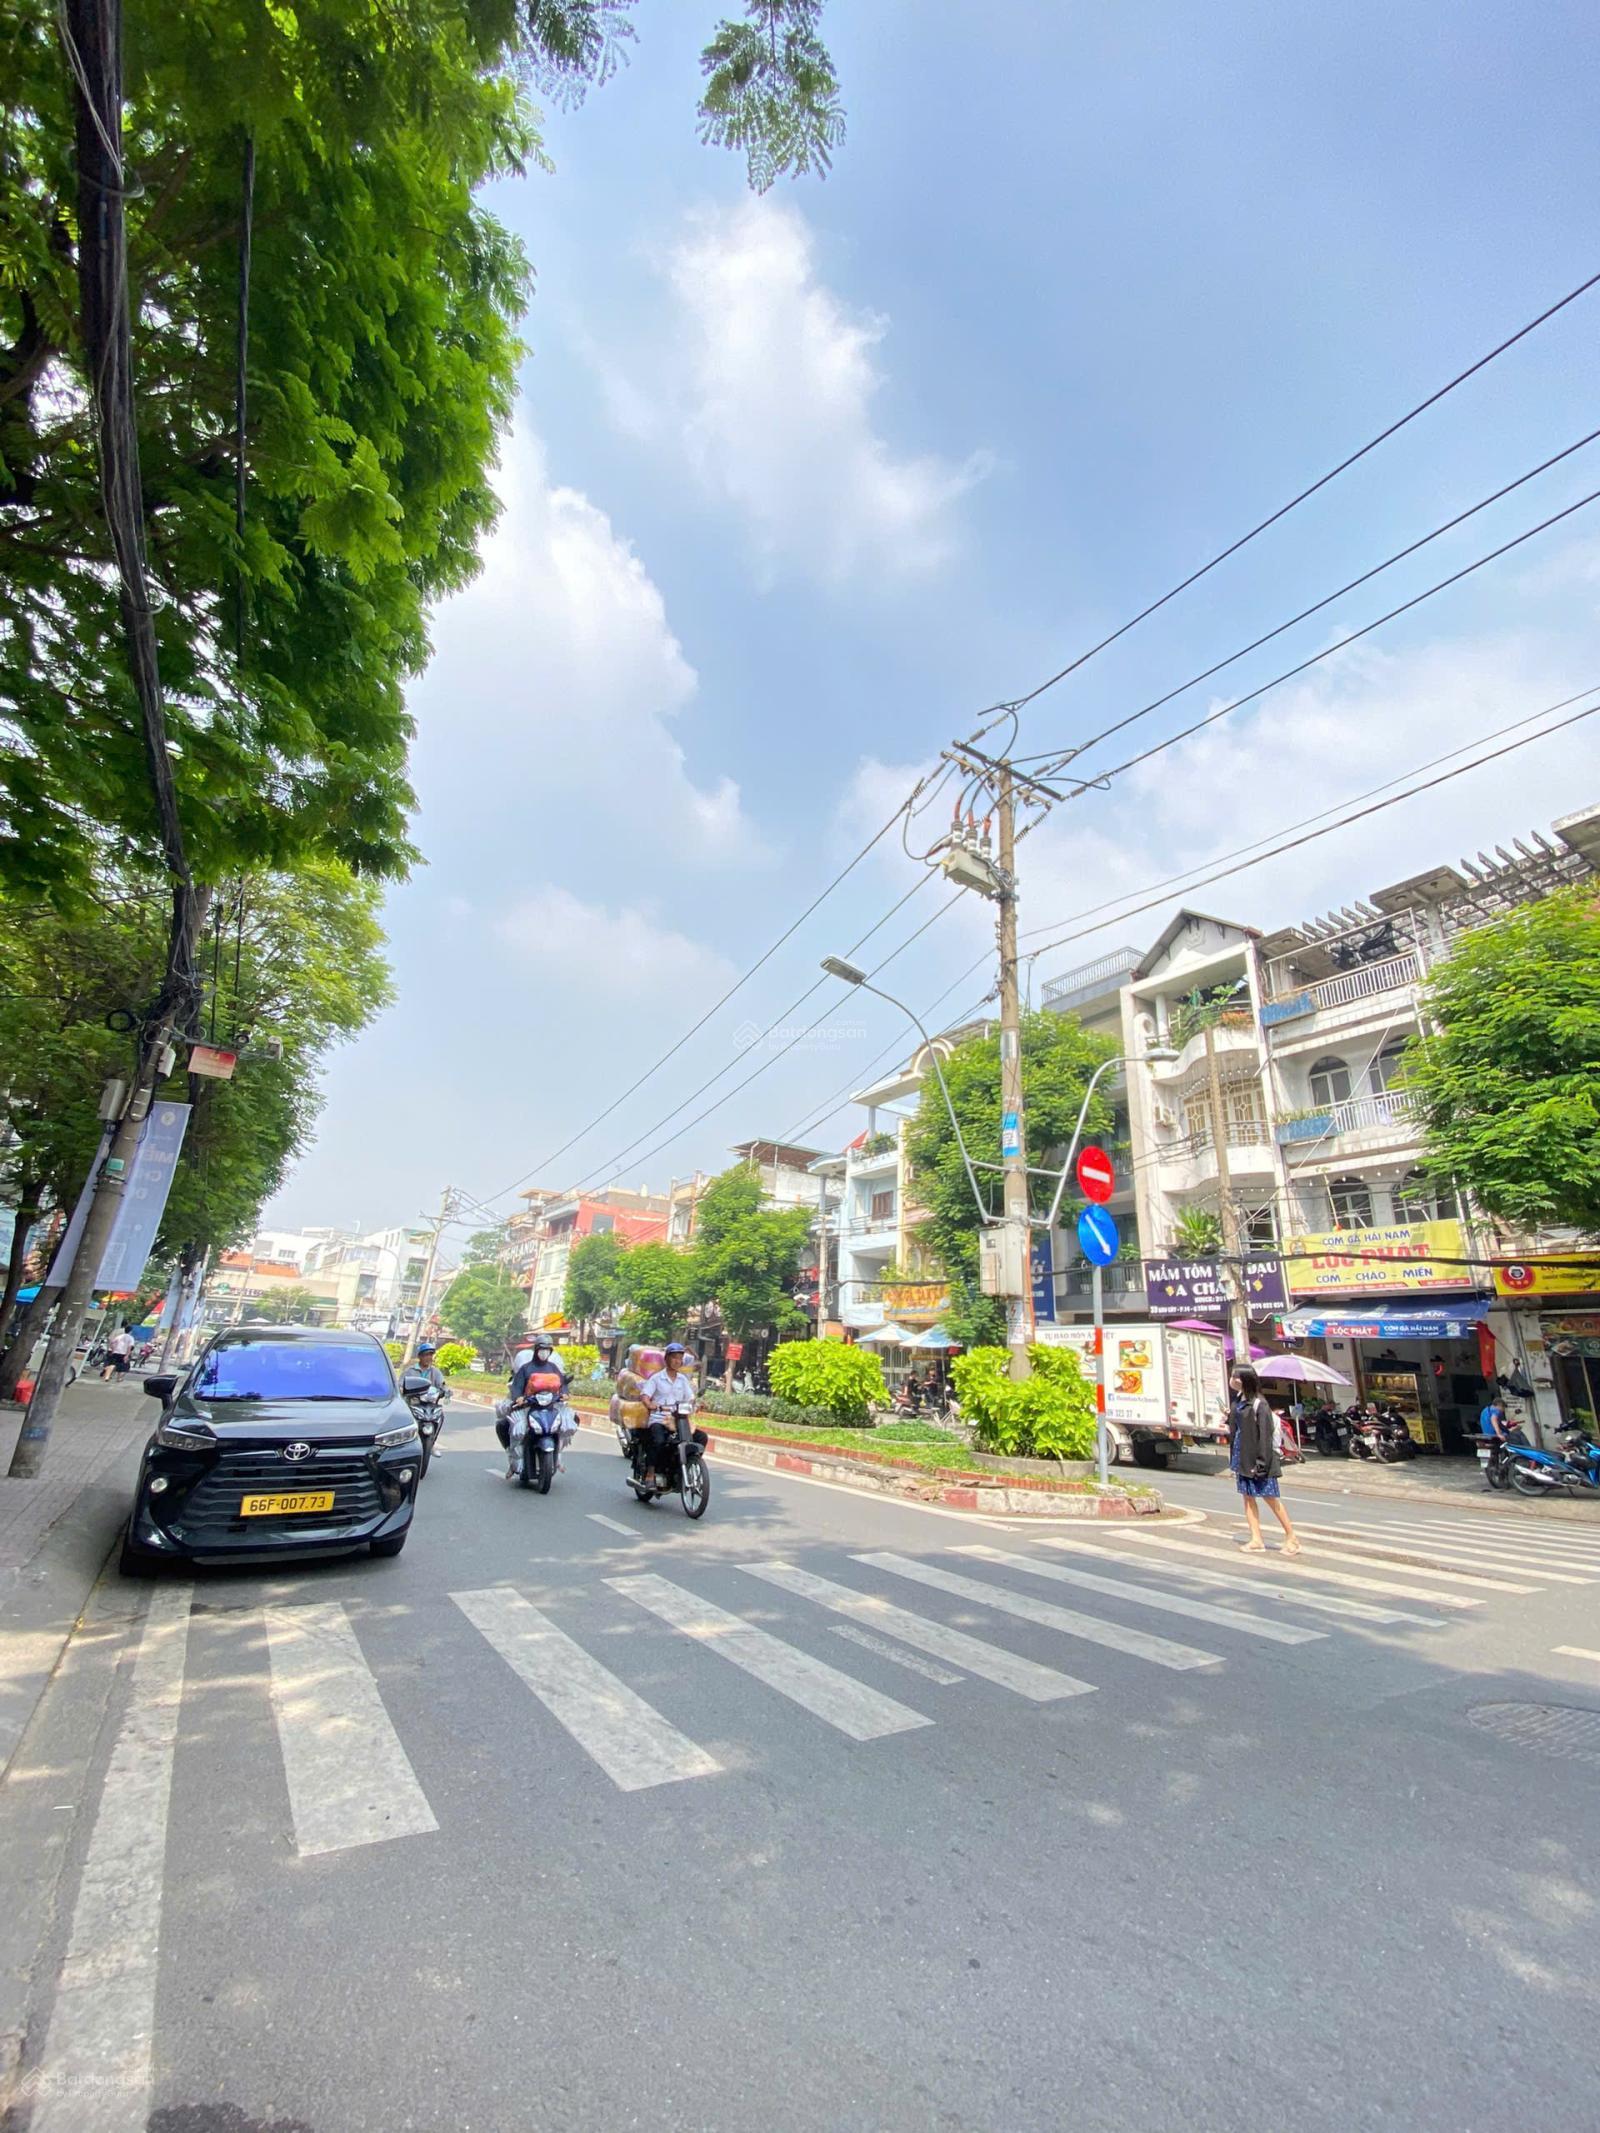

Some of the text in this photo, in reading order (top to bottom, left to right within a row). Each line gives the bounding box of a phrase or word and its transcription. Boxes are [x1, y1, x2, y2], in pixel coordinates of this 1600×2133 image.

[1385, 1229, 1411, 1240] NAM
[1148, 1263, 1179, 1281] MẮM
[1182, 1263, 1213, 1279] TÔM
[1175, 1284, 1188, 1297] A
[249, 1496, 326, 1512] 66F-007.73
